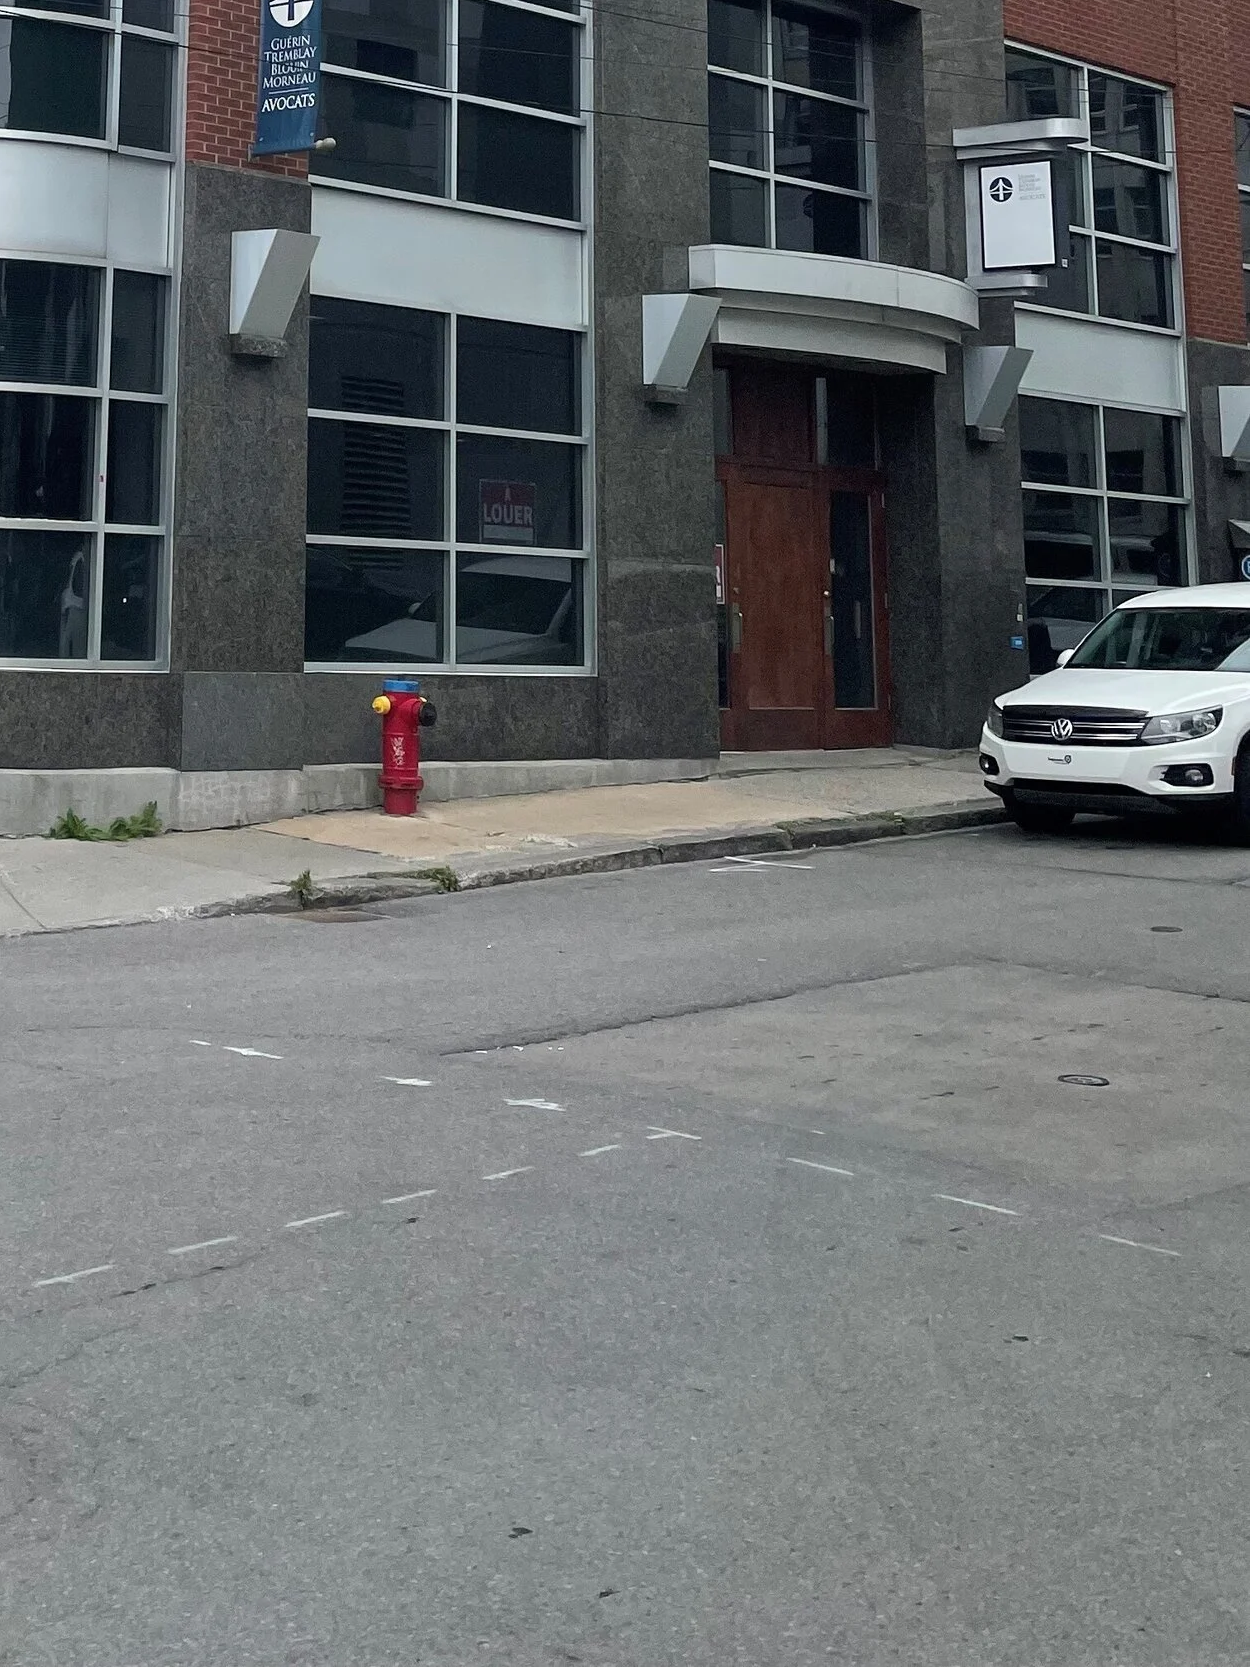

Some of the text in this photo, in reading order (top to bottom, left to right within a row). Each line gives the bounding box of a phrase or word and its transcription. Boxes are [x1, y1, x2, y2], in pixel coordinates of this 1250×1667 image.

[270, 34, 311, 51] GUÉRIN
[263, 46, 317, 63] TREMBLAY
[262, 71, 316, 89] MORNEAU
[261, 92, 316, 113] AVOCATS
[483, 502, 533, 526] LOUER
